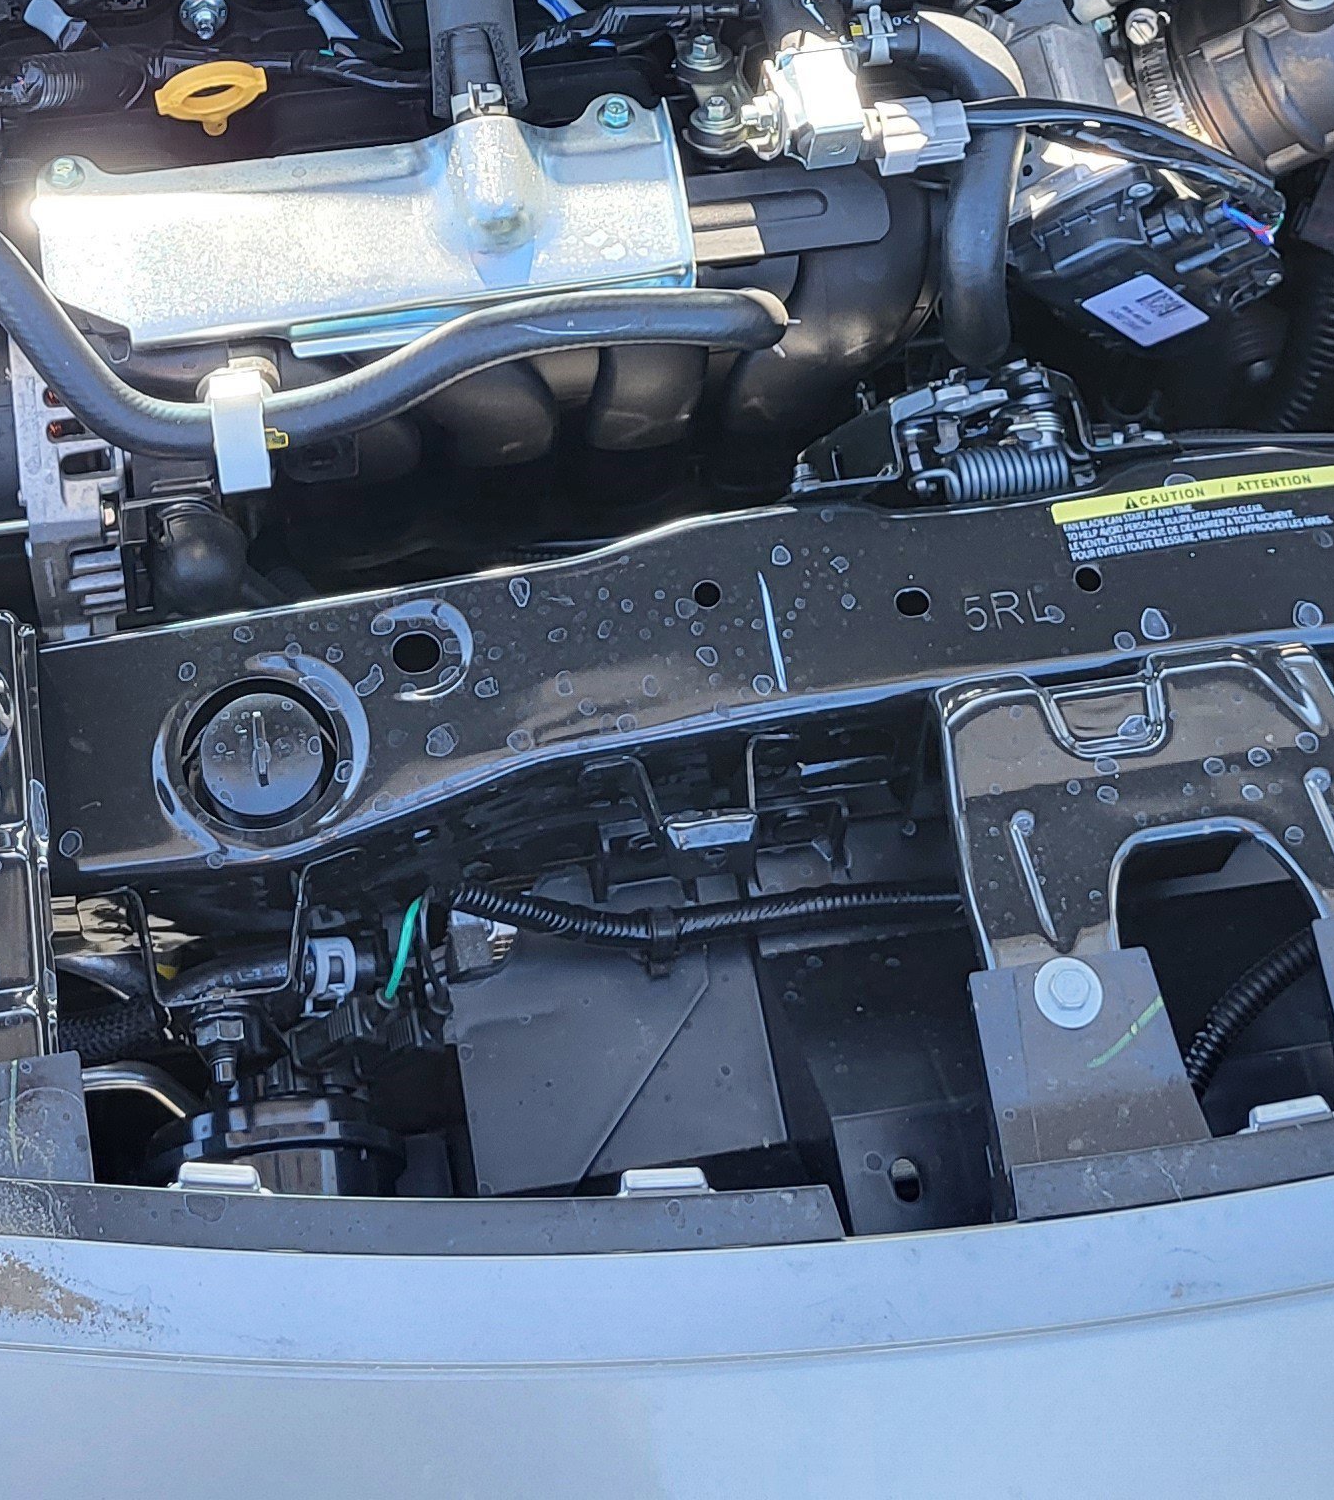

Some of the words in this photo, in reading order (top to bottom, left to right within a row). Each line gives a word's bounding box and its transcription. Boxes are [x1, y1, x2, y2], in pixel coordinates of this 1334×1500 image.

[1139, 486, 1205, 506] CAUTION
[1237, 473, 1312, 492] ATTENTION
[1063, 522, 1079, 533] FAN
[1079, 519, 1105, 531] BLADE
[1105, 516, 1123, 527] CAN
[1123, 511, 1146, 523] START
[1147, 509, 1157, 519] AT
[1066, 532, 1078, 542] TO
[1078, 529, 1099, 540] HELP
[1099, 525, 1123, 537] AVOID
[1124, 520, 1163, 533] PERSONAL
[1192, 510, 1210, 521] KEEP
[1211, 507, 1239, 518] HANDS
[1068, 542, 1079, 551] LE
[1078, 533, 1135, 549] VENTILATEUR
[1136, 528, 1166, 541] RISQUE
[1167, 525, 1179, 535] DE
[1234, 513, 1255, 525] TOUT
[1071, 550, 1096, 562] POUR
[1127, 540, 1153, 552] TOUTE
[1197, 531, 1210, 541] NE
[1211, 527, 1227, 539] PAS
[1227, 525, 1240, 536] EN
[1241, 520, 1288, 534] APPROCHER
[1289, 518, 1303, 529] LES
